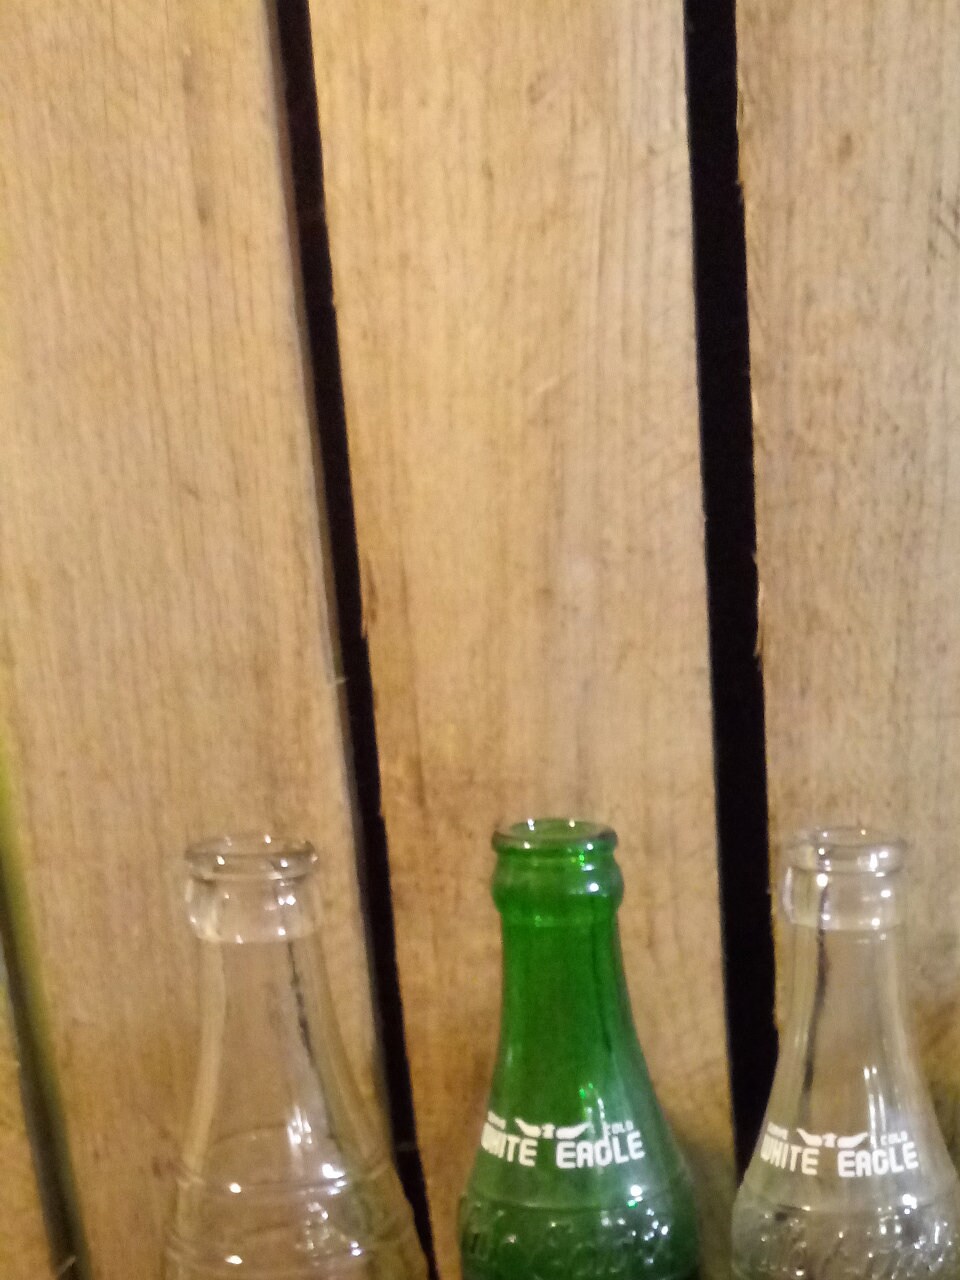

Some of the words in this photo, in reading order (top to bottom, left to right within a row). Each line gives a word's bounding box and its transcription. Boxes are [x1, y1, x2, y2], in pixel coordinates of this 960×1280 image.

[556, 1131, 645, 1169] EAGLE
[760, 1134, 820, 1176] WHITE
[837, 1141, 919, 1178] EAGLE
